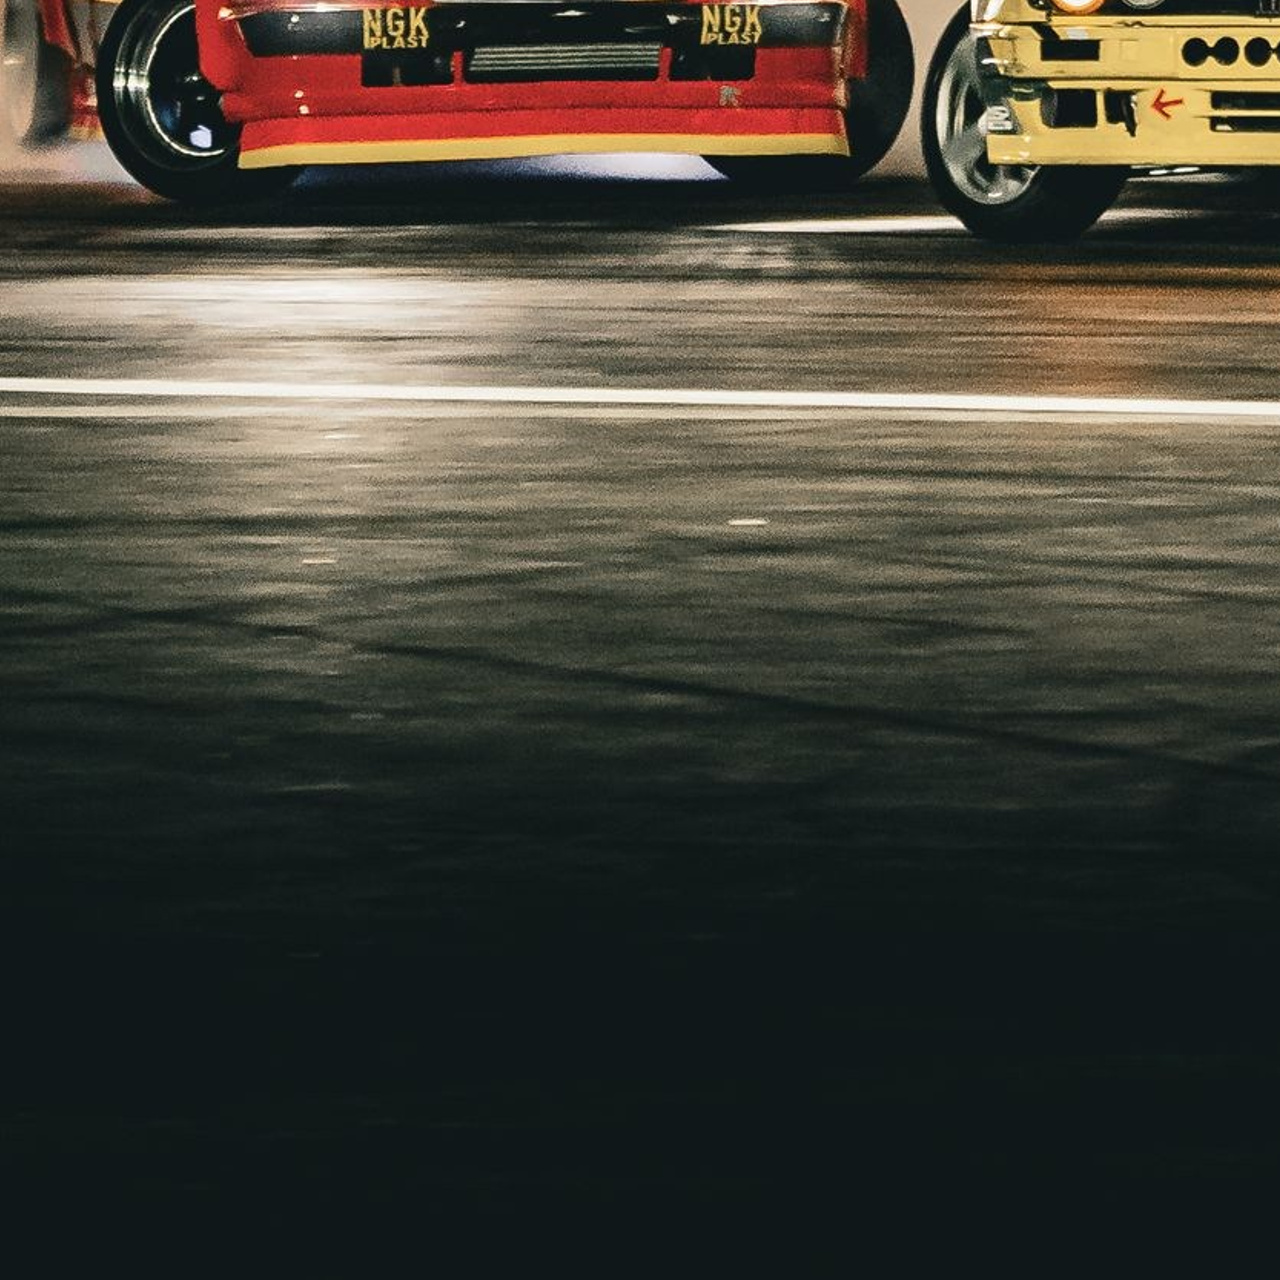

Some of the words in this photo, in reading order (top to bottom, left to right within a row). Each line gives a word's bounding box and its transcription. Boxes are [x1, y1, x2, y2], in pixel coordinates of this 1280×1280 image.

[363, 7, 429, 42] NGK
[701, 4, 761, 39] NGK
[370, 35, 429, 49] PLAST
[707, 32, 761, 45] PLAST
